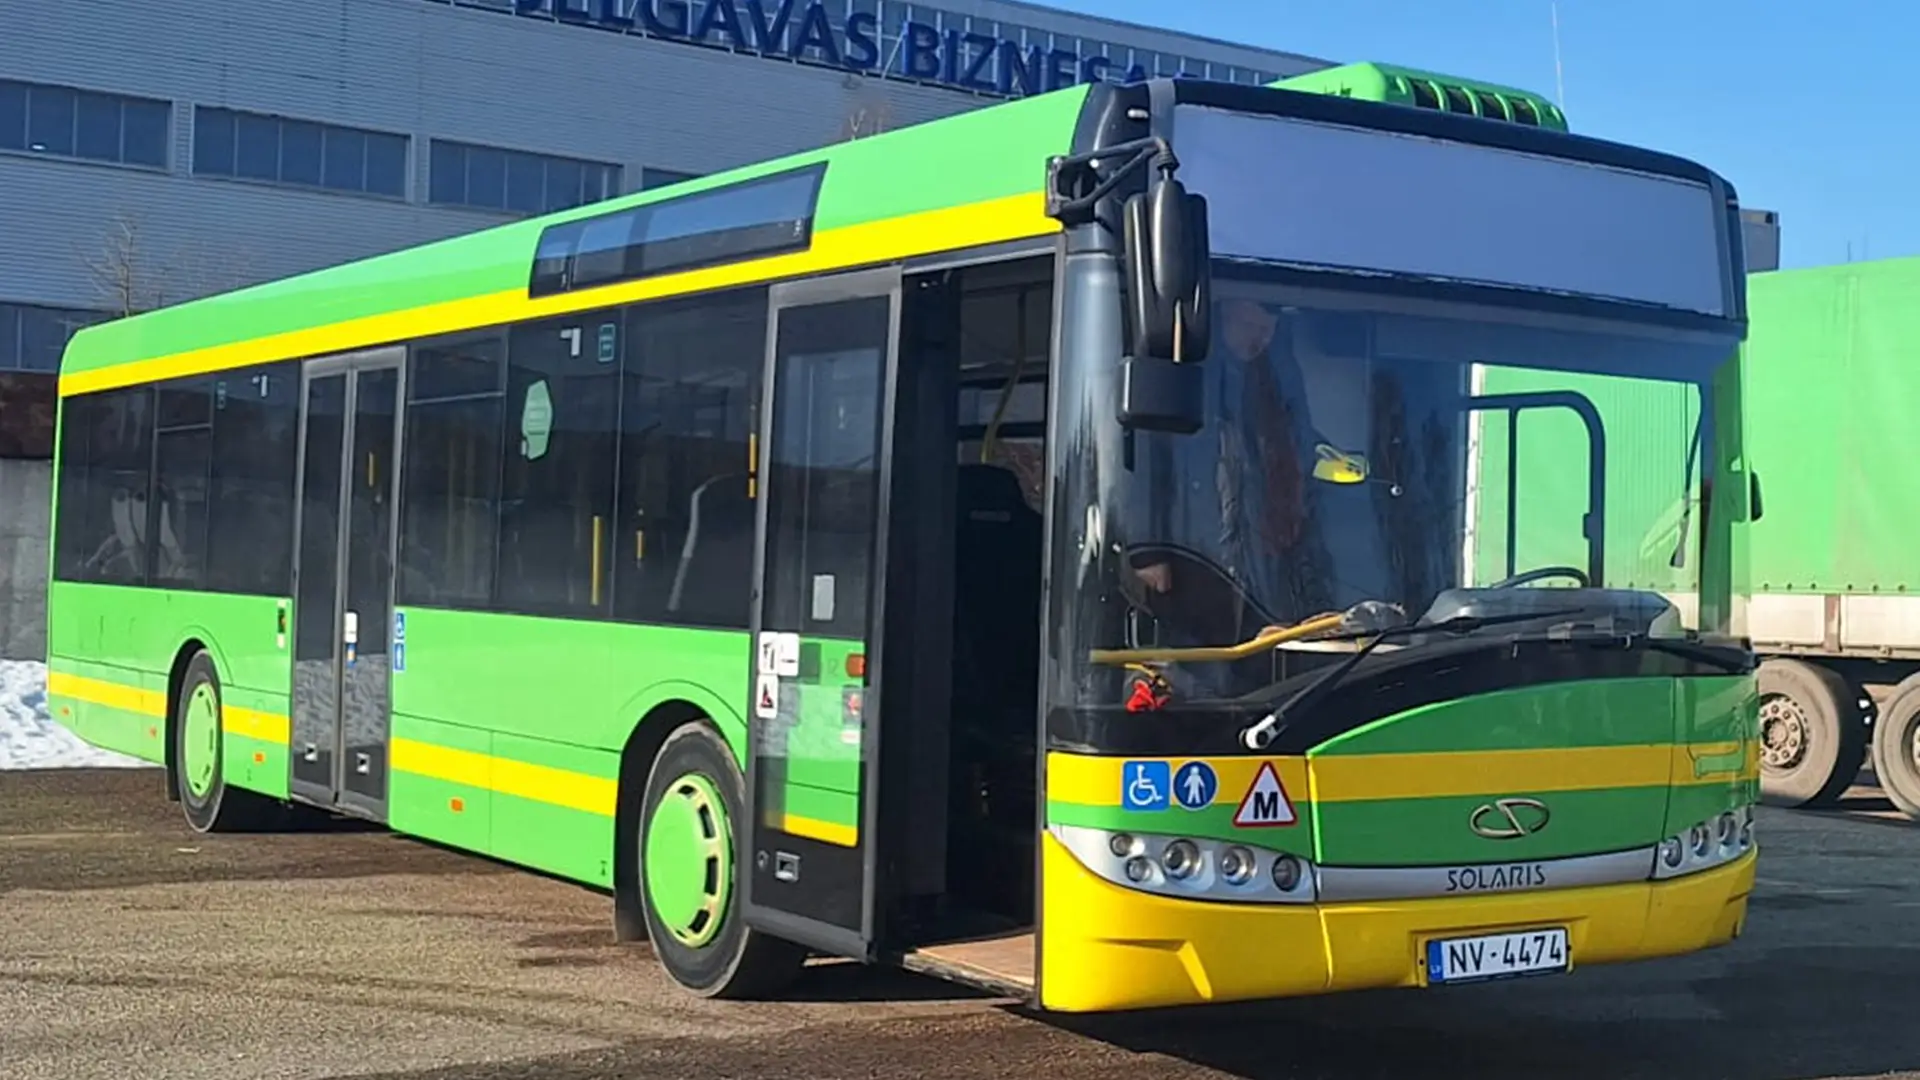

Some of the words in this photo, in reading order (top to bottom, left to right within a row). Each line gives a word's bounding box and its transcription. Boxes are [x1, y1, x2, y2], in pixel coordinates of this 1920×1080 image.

[515, 0, 880, 71] GAVAS
[1253, 791, 1278, 820] M
[1446, 864, 1545, 891] SOLARIS
